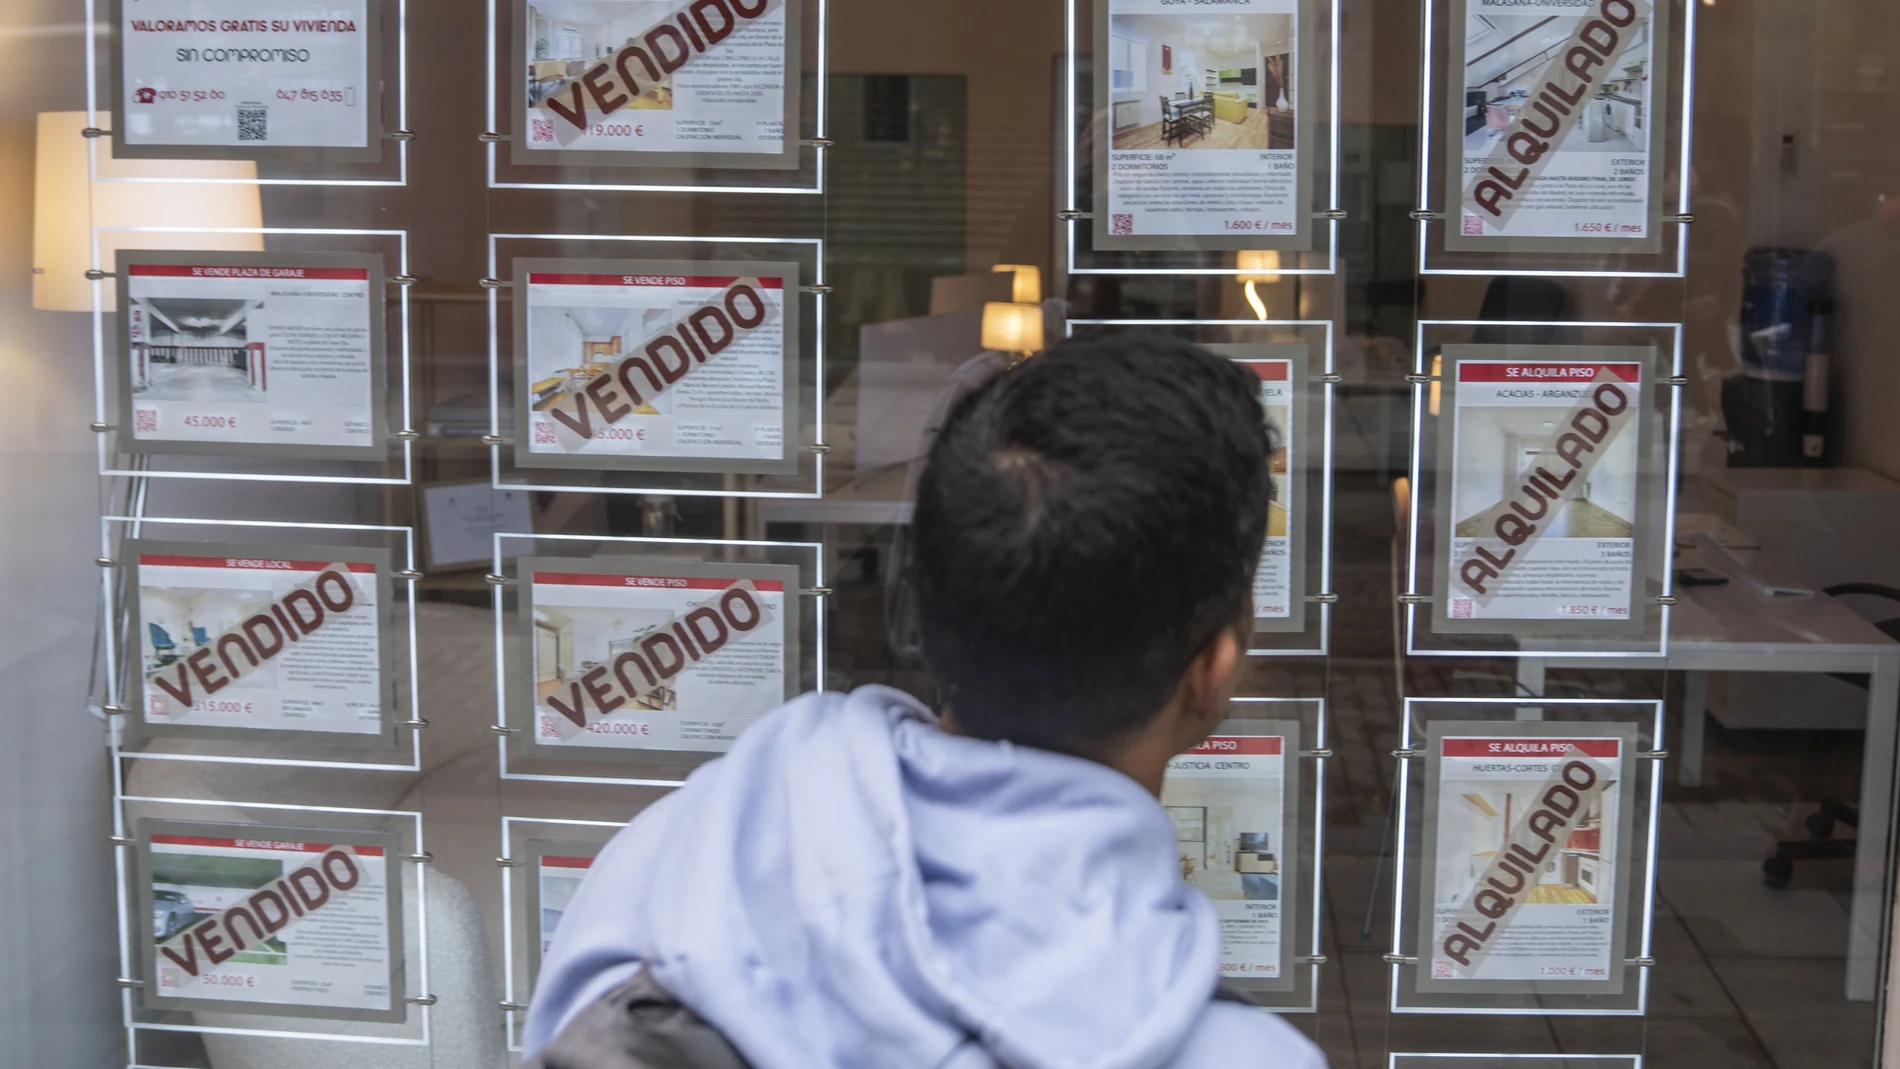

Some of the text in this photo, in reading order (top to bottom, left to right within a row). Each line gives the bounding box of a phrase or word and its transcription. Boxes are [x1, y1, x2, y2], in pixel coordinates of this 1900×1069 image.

[131, 20, 356, 32] VALORAMOS GRATIS SU VIVIENDA
[176, 48, 310, 63] SIN COMPROMISO
[1474, 0, 1636, 217] ALQUILADO
[635, 124, 644, 137] €
[1224, 220, 1252, 230] 1.600
[1255, 220, 1262, 230] €
[1271, 222, 1293, 230] mes
[1574, 223, 1602, 232] 1.650
[1604, 223, 1611, 232] €
[192, 268, 203, 276] SE
[622, 276, 686, 286] SE VENDE PISO
[552, 284, 766, 440] VENDIDO
[1505, 367, 1595, 378] SE ALQUILA PISO
[183, 415, 236, 428] 45.000 €
[636, 429, 646, 440] €
[1460, 382, 1628, 595] ALQUILADO
[625, 577, 687, 587] SE VENDE PISO
[1263, 605, 1284, 613] mes
[1591, 605, 1598, 614] €
[1607, 607, 1628, 615] mes
[154, 570, 353, 708] VENDIDO
[546, 588, 760, 728] VENDIDO
[244, 702, 253, 714] €
[641, 724, 649, 736] €
[1212, 740, 1238, 750] PISO
[1488, 743, 1574, 753] SE ALQUILA PISO
[1215, 762, 1250, 770] CENTRO
[1443, 760, 1596, 966] ALQUILADO
[161, 850, 359, 977] VENDIDO
[1239, 963, 1246, 972] €
[203, 973, 255, 987] 50.000 €
